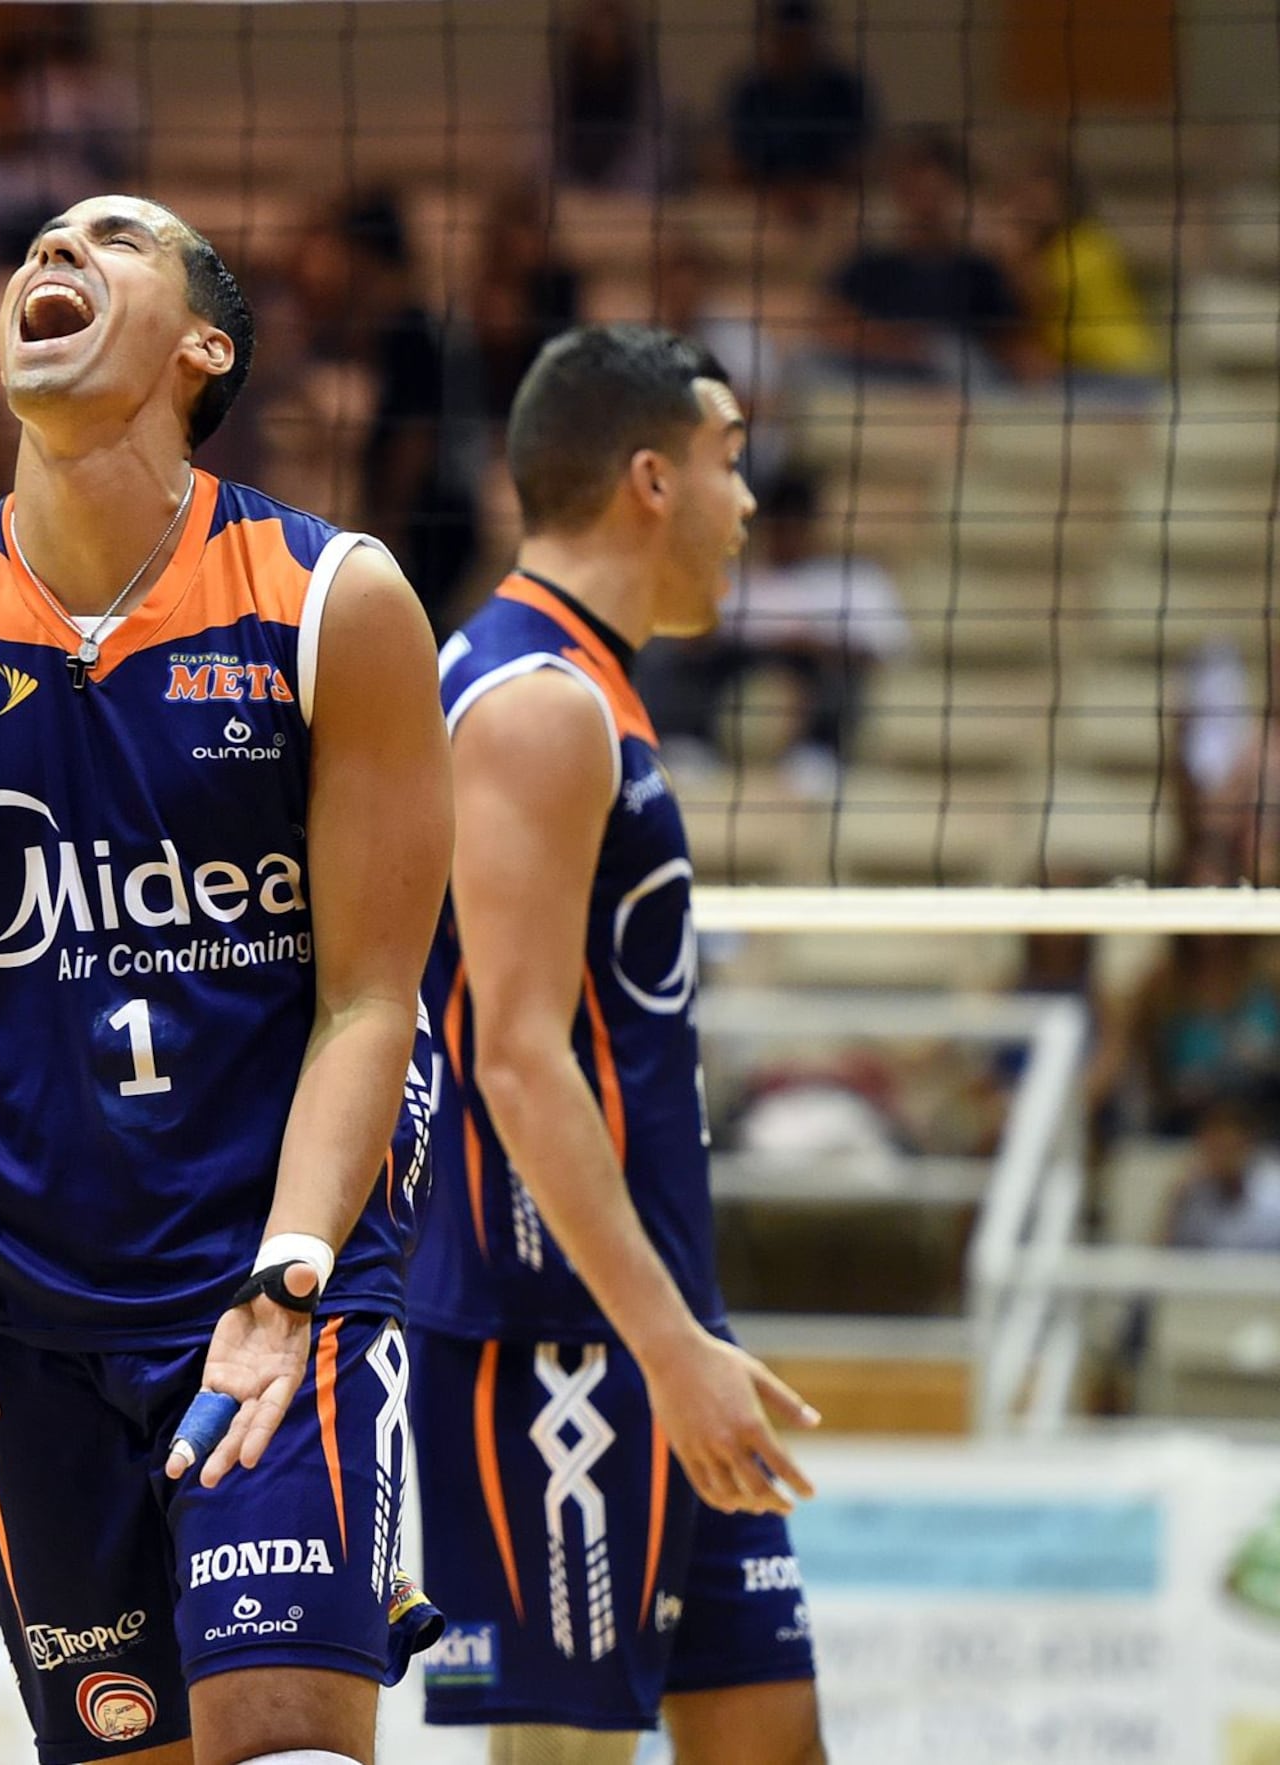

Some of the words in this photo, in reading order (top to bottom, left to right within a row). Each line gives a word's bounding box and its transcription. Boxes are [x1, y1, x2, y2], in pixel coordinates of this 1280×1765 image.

[58, 947, 98, 981] Air
[108, 930, 312, 977] Conditioning
[108, 998, 172, 1096] 1
[190, 1539, 334, 1589] HONDA
[47, 1610, 146, 1657] TROPICO
